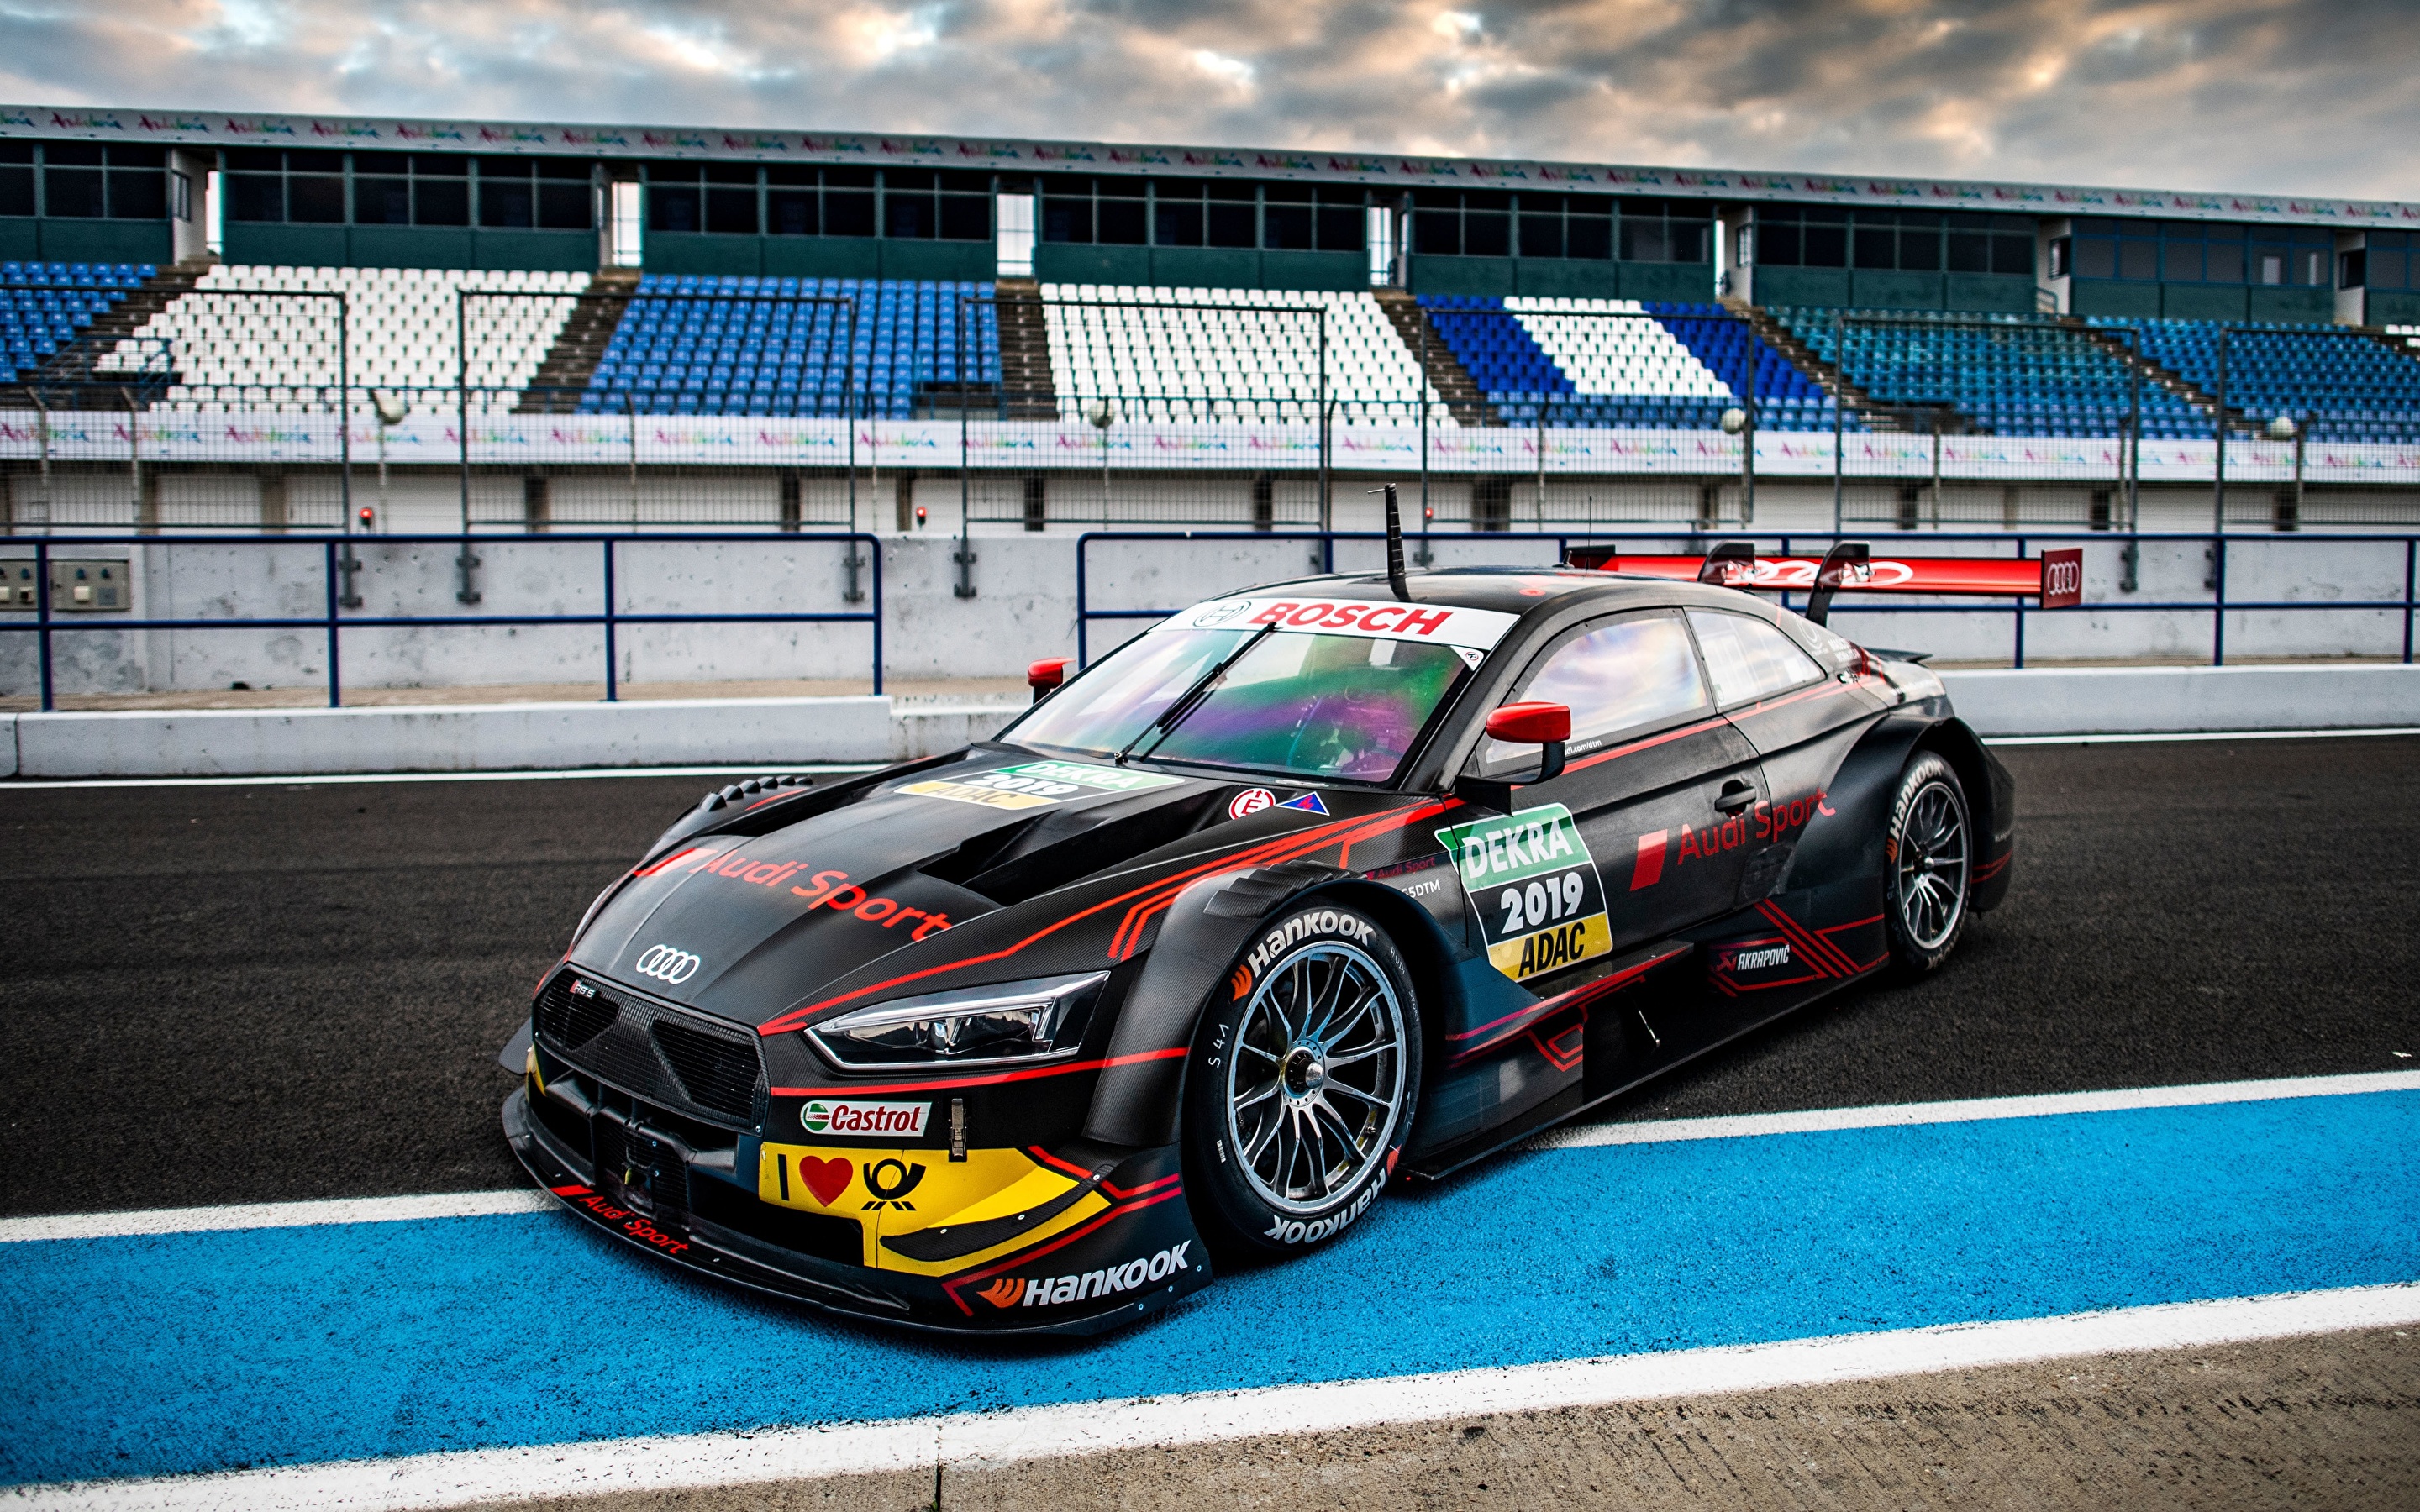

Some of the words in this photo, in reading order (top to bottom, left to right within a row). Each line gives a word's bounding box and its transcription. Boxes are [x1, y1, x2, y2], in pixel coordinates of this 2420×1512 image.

[1248, 602, 1454, 636] BOSCH
[933, 785, 1018, 804] ADAC
[965, 774, 1079, 796] 2019
[1015, 764, 1144, 789] DEKRA
[1461, 817, 1574, 879] DEKRA
[1677, 811, 1746, 865] Audi
[1754, 787, 1836, 843] Sport
[1376, 864, 1404, 880] Audi
[1405, 857, 1435, 873] Sport
[689, 849, 808, 887] Audi
[790, 870, 954, 942] Sport
[1500, 871, 1584, 934] 2019
[1518, 921, 1586, 979] ADAC
[831, 1105, 921, 1131] Castrol
[777, 1153, 791, 1201] I
[578, 1195, 636, 1221] Aud
[623, 1218, 689, 1254] Sport
